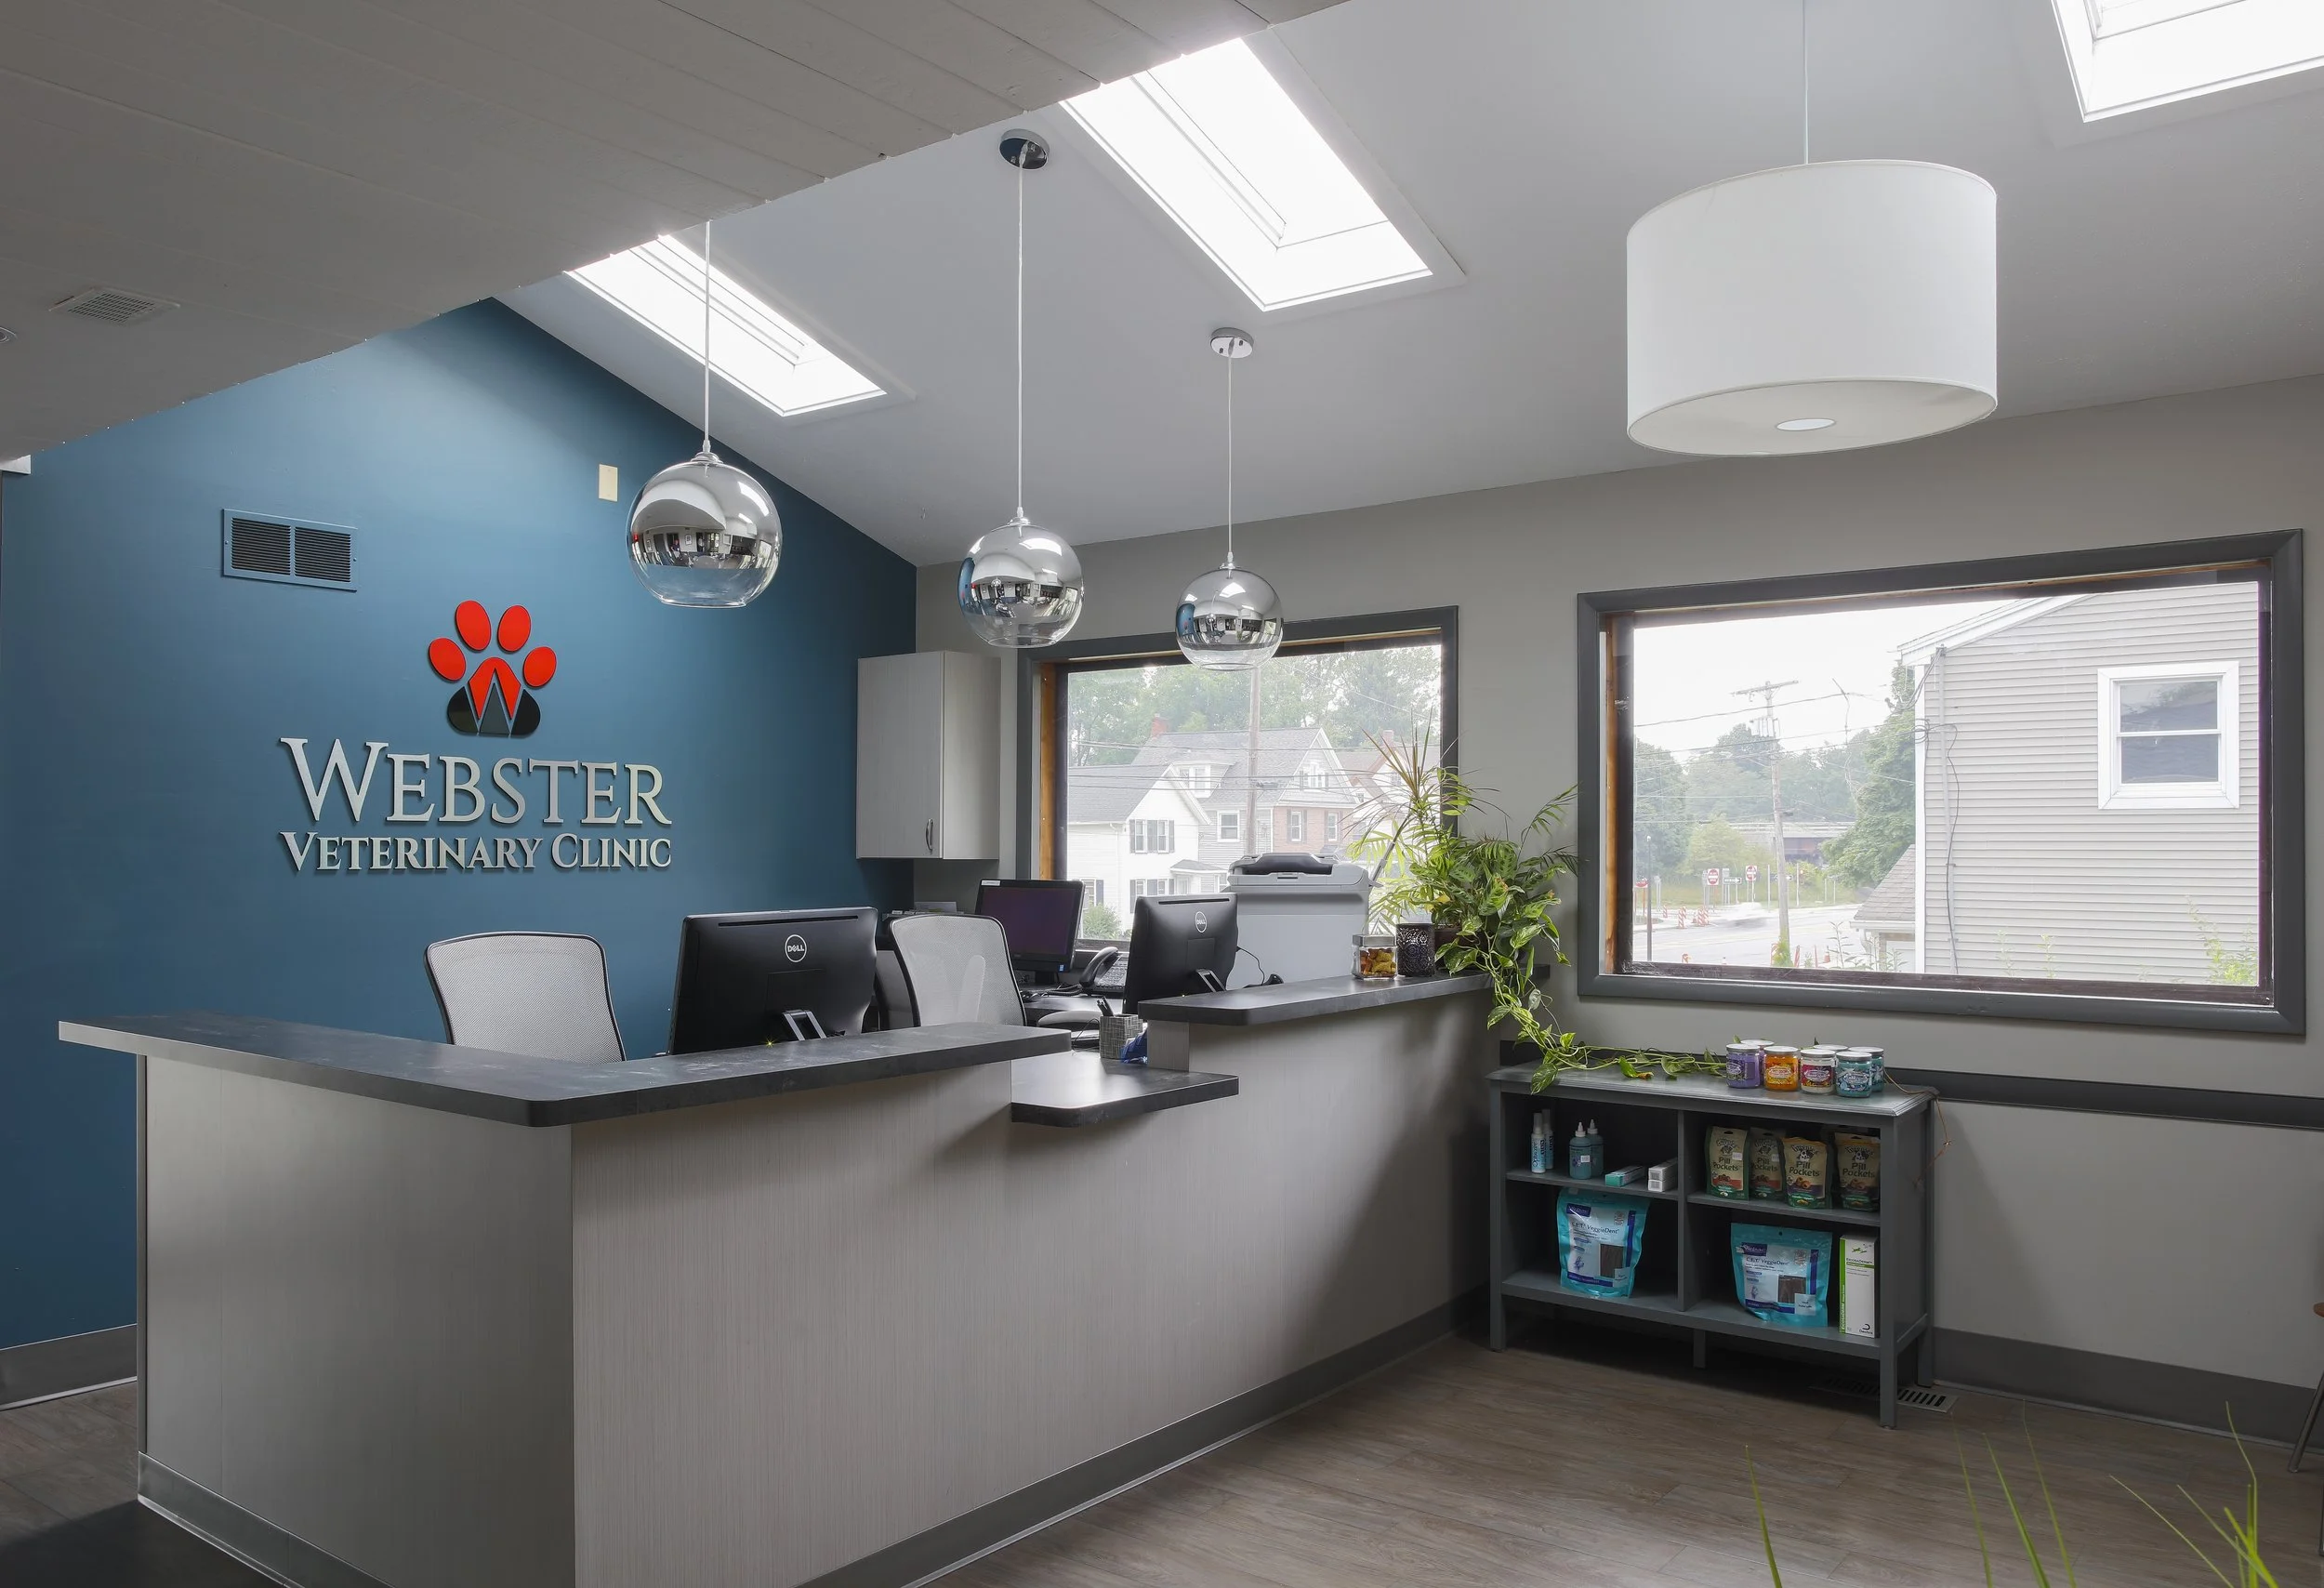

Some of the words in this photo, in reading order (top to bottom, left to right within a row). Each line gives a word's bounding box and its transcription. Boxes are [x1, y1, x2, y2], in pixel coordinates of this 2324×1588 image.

[280, 737, 672, 826] WEBSTER
[280, 831, 543, 872] VETERINARY
[551, 832, 672, 868] CLINIC
[786, 944, 805, 953] DELL
[1712, 1161, 1738, 1171] Pockets
[1796, 1160, 1811, 1169] Pill
[1851, 1162, 1867, 1171] Pill
[1789, 1166, 1820, 1177] Pockets
[1842, 1168, 1875, 1178] Pockets
